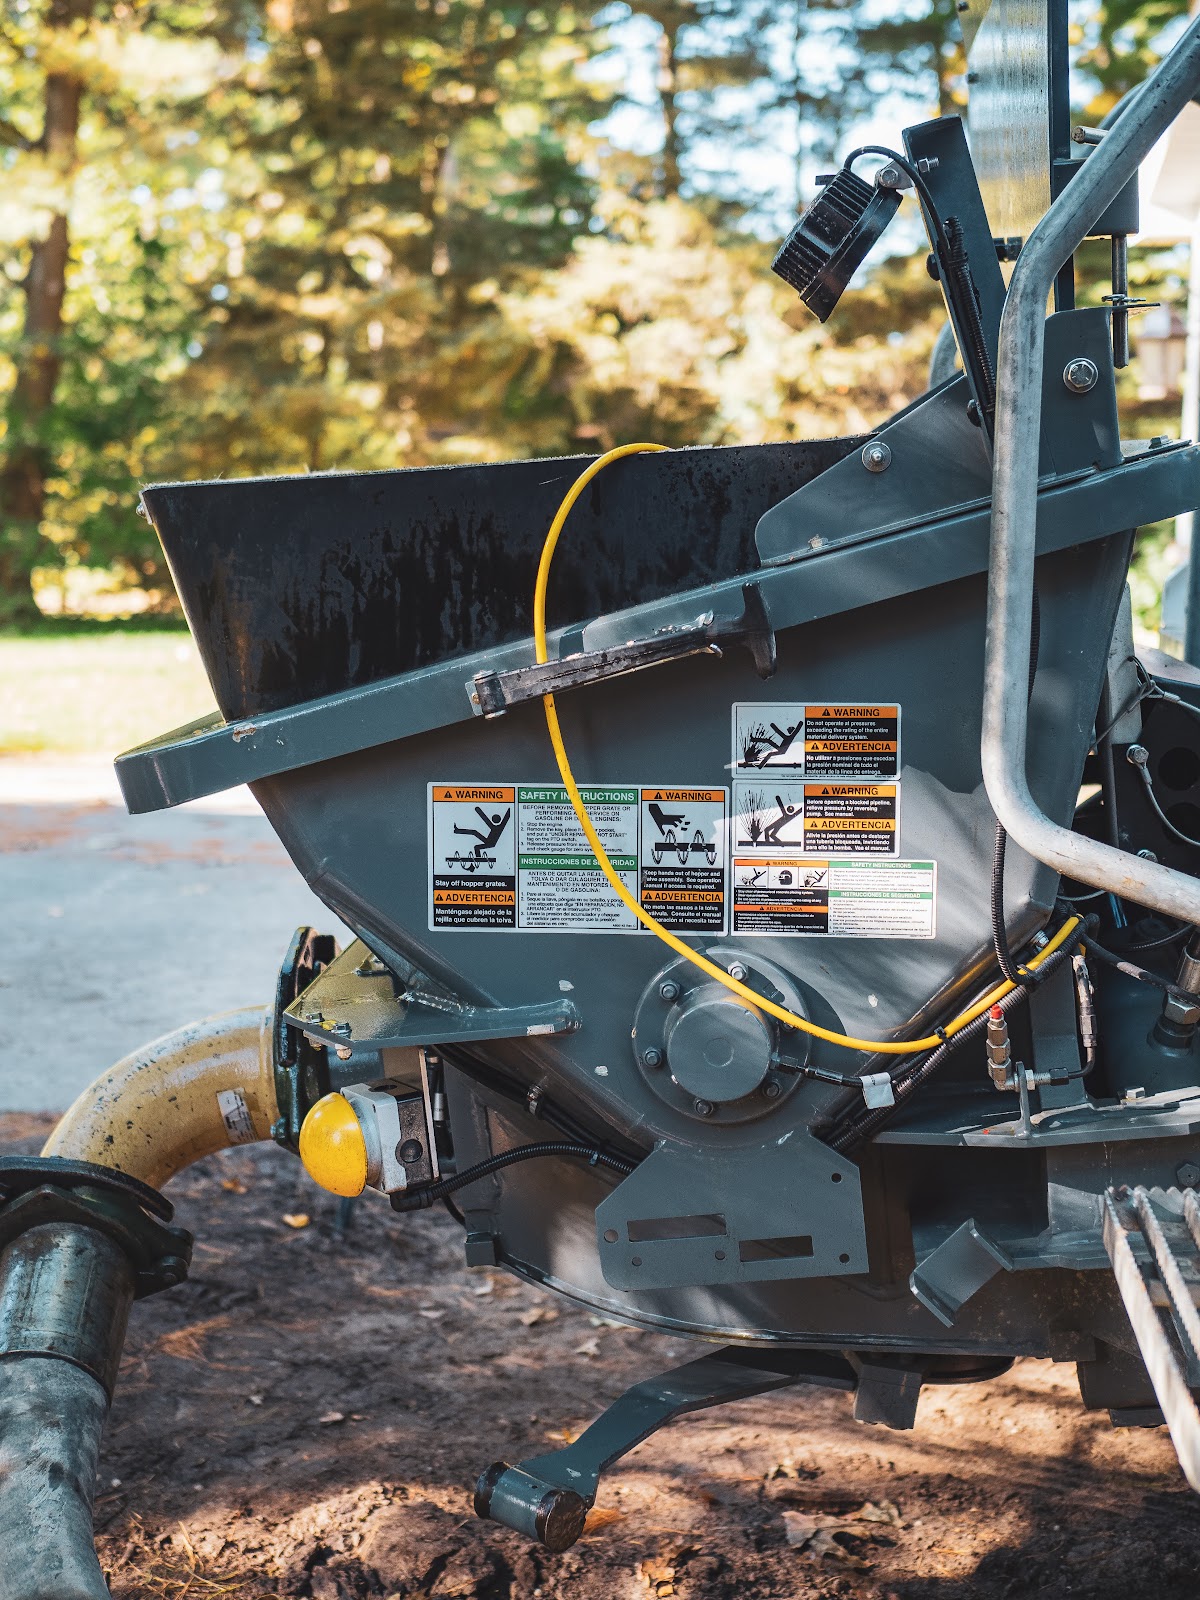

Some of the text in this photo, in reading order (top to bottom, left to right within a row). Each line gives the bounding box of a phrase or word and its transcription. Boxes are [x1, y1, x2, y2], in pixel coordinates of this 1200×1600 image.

[520, 792, 634, 801] SAFETY INTRUCTIONS
[445, 893, 514, 902] ADVERTENCIA
[654, 893, 721, 901] ADVERTENCIA
